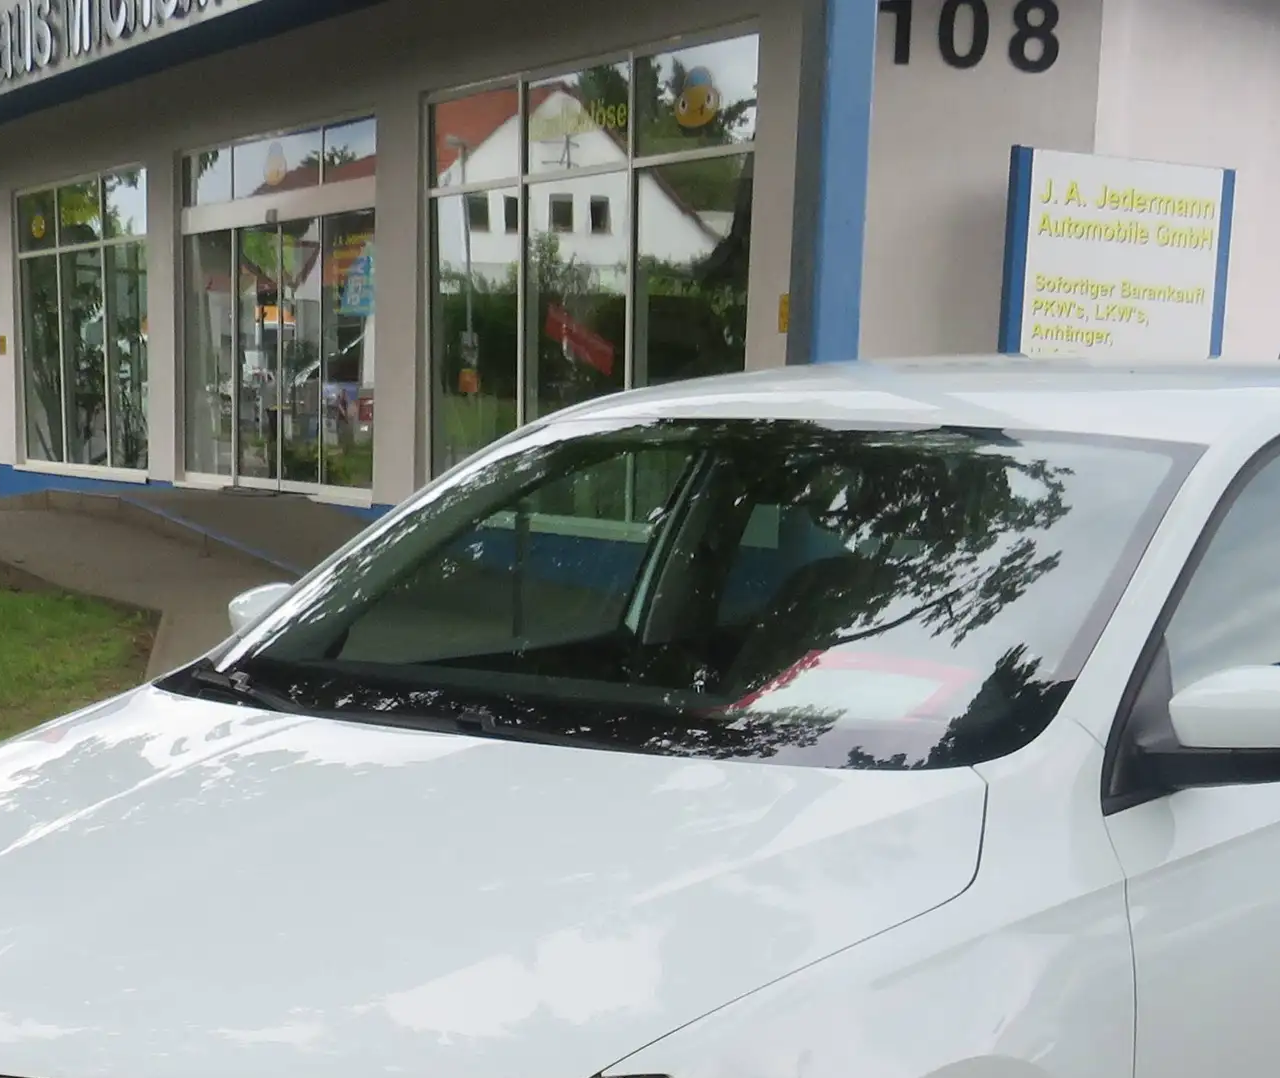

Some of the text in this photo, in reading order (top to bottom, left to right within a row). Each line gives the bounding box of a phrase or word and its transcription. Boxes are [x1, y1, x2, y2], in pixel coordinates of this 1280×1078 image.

[879, 0, 1060, 73] 108
[1064, 180, 1087, 208] A.
[1095, 185, 1216, 220] Jedermann
[1037, 213, 1214, 251] Automobile GmbH
[1034, 272, 1116, 301] Sofortiger
